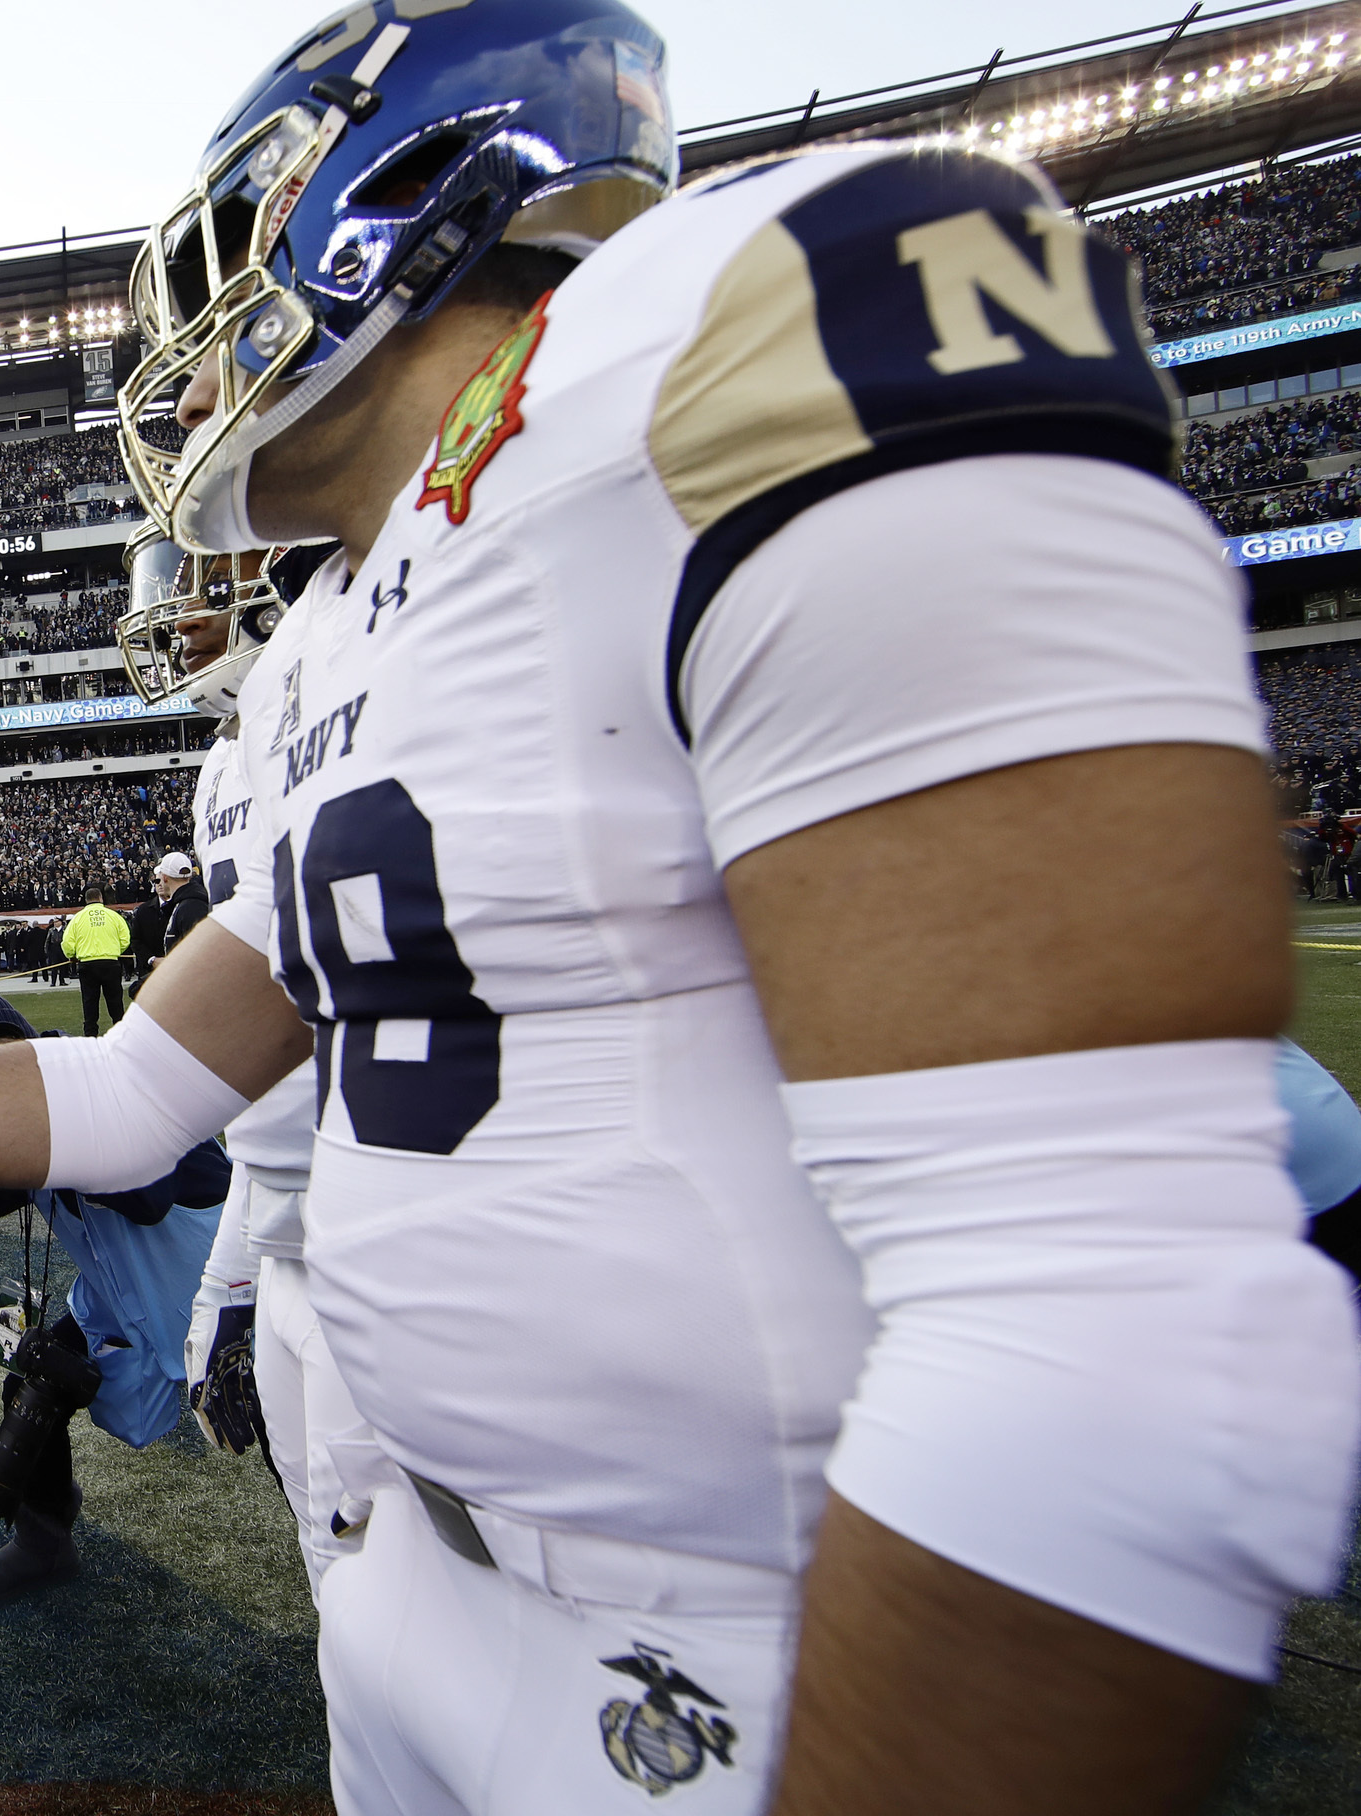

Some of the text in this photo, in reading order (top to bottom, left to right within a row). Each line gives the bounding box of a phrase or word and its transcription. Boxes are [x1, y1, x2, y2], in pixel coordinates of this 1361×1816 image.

[896, 205, 1116, 376] N
[1167, 348, 1187, 360] to
[1193, 341, 1225, 354] the
[1231, 326, 1281, 346] 119th
[85, 350, 110, 374] 15
[1242, 531, 1346, 558] Game
[70, 701, 124, 719] Game
[284, 691, 368, 798] NAVY
[208, 798, 252, 845] NAVY
